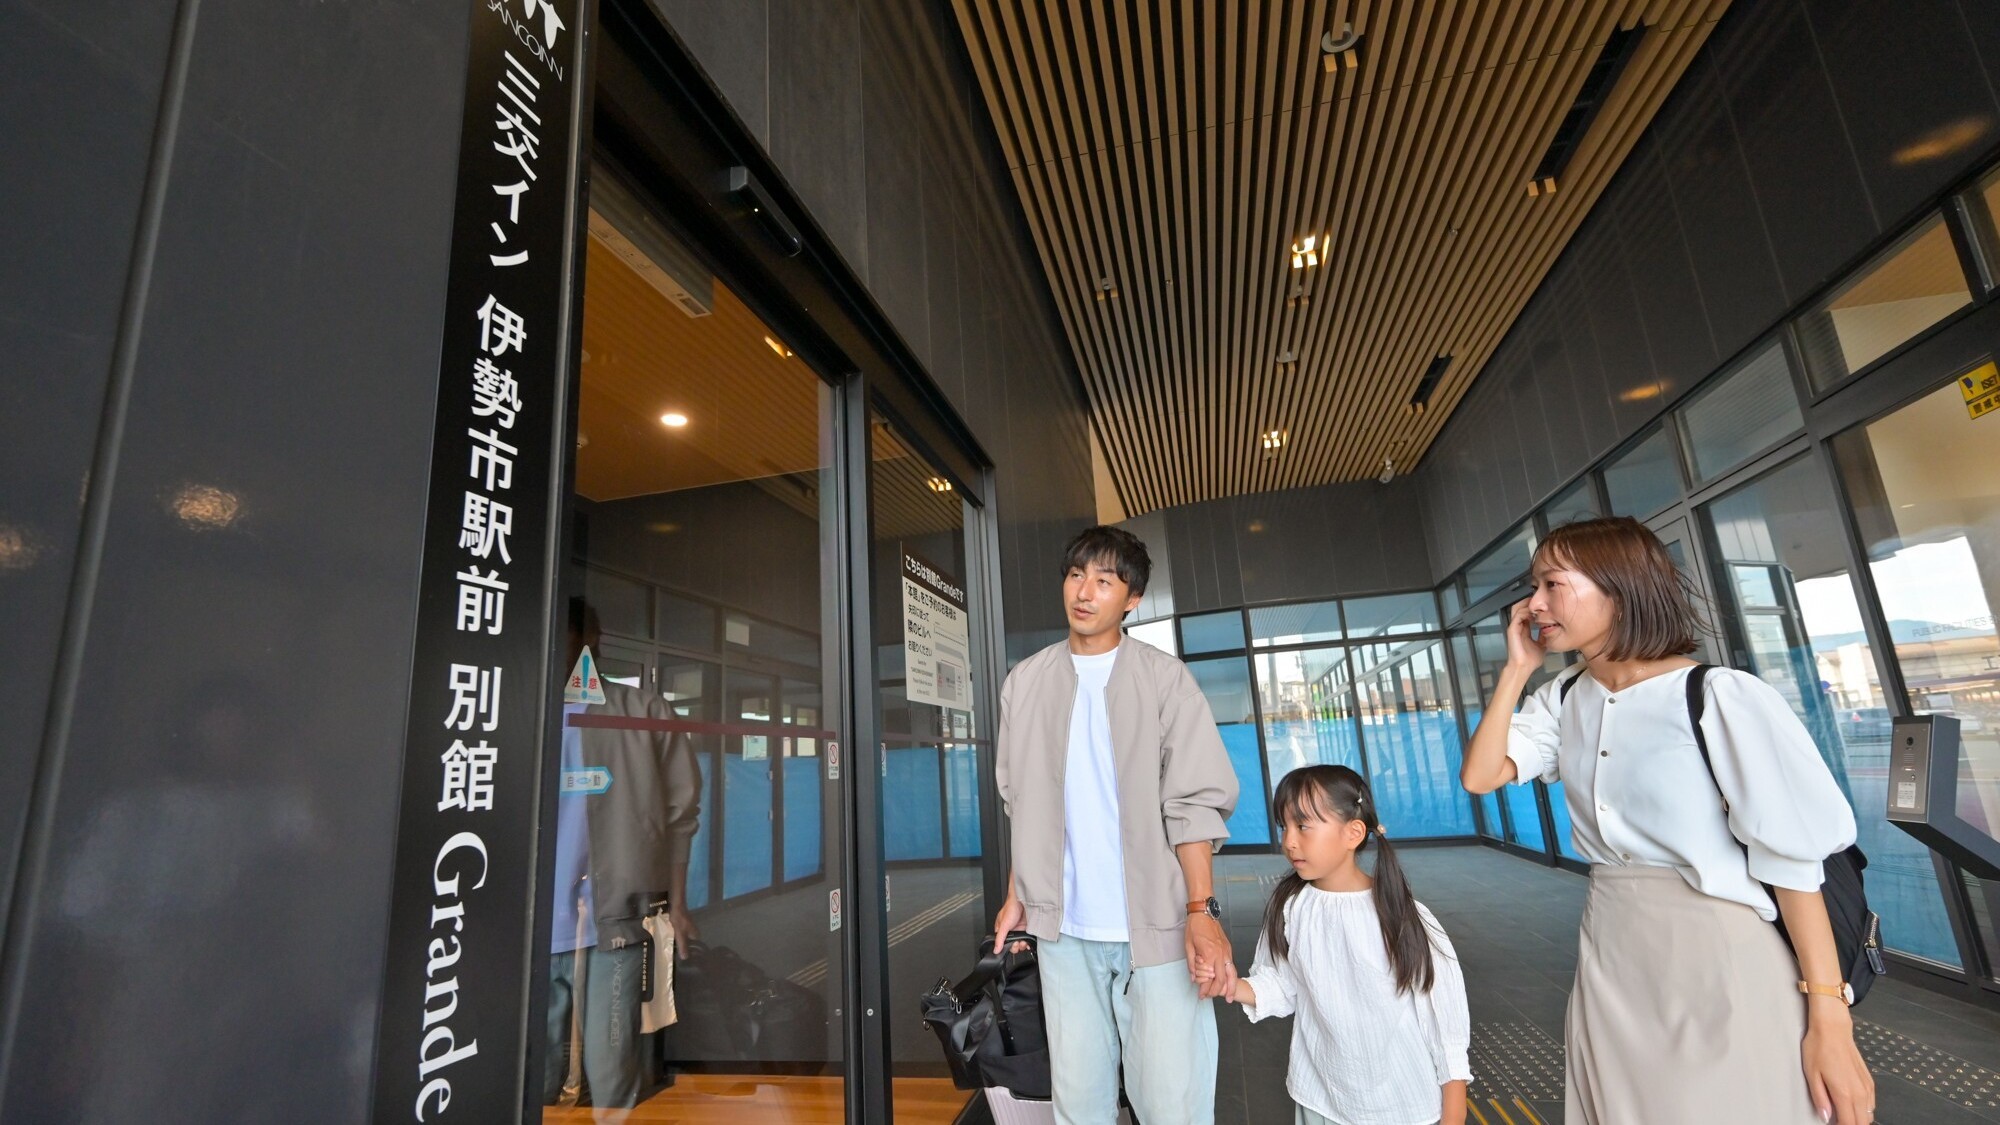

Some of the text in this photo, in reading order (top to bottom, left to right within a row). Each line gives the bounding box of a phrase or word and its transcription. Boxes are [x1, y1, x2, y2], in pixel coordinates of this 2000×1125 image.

[414, 50, 541, 1124] 三交イン 伊勢市駅前 別館 Grande
